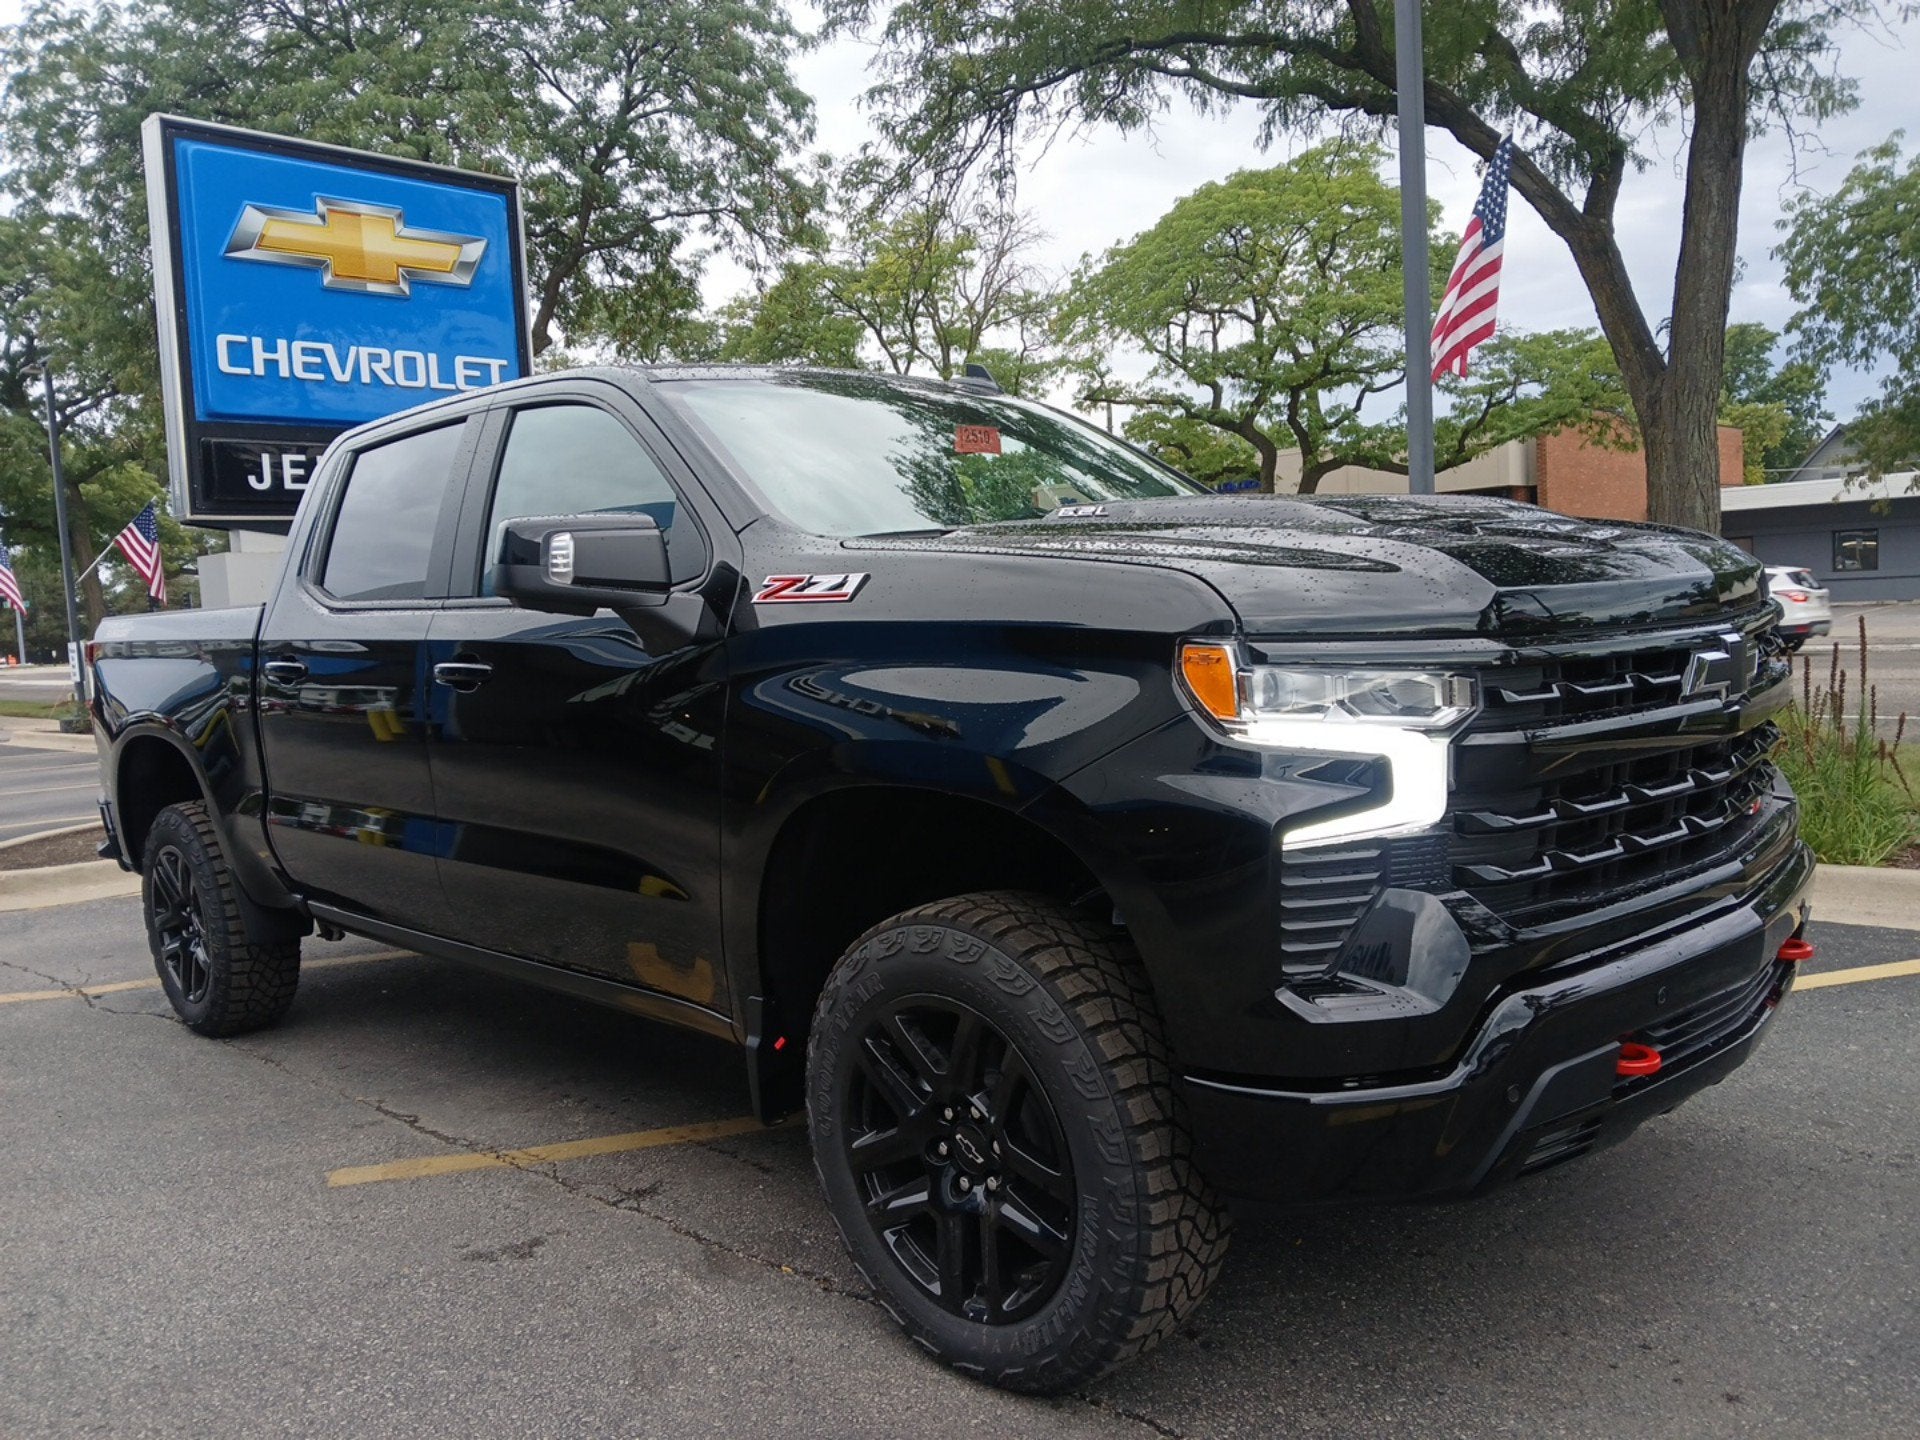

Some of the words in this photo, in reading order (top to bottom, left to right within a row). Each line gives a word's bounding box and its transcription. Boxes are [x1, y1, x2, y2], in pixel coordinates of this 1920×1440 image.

[216, 334, 508, 390] CHEVROLET
[247, 451, 323, 491] JE
[751, 571, 871, 605] Z71
